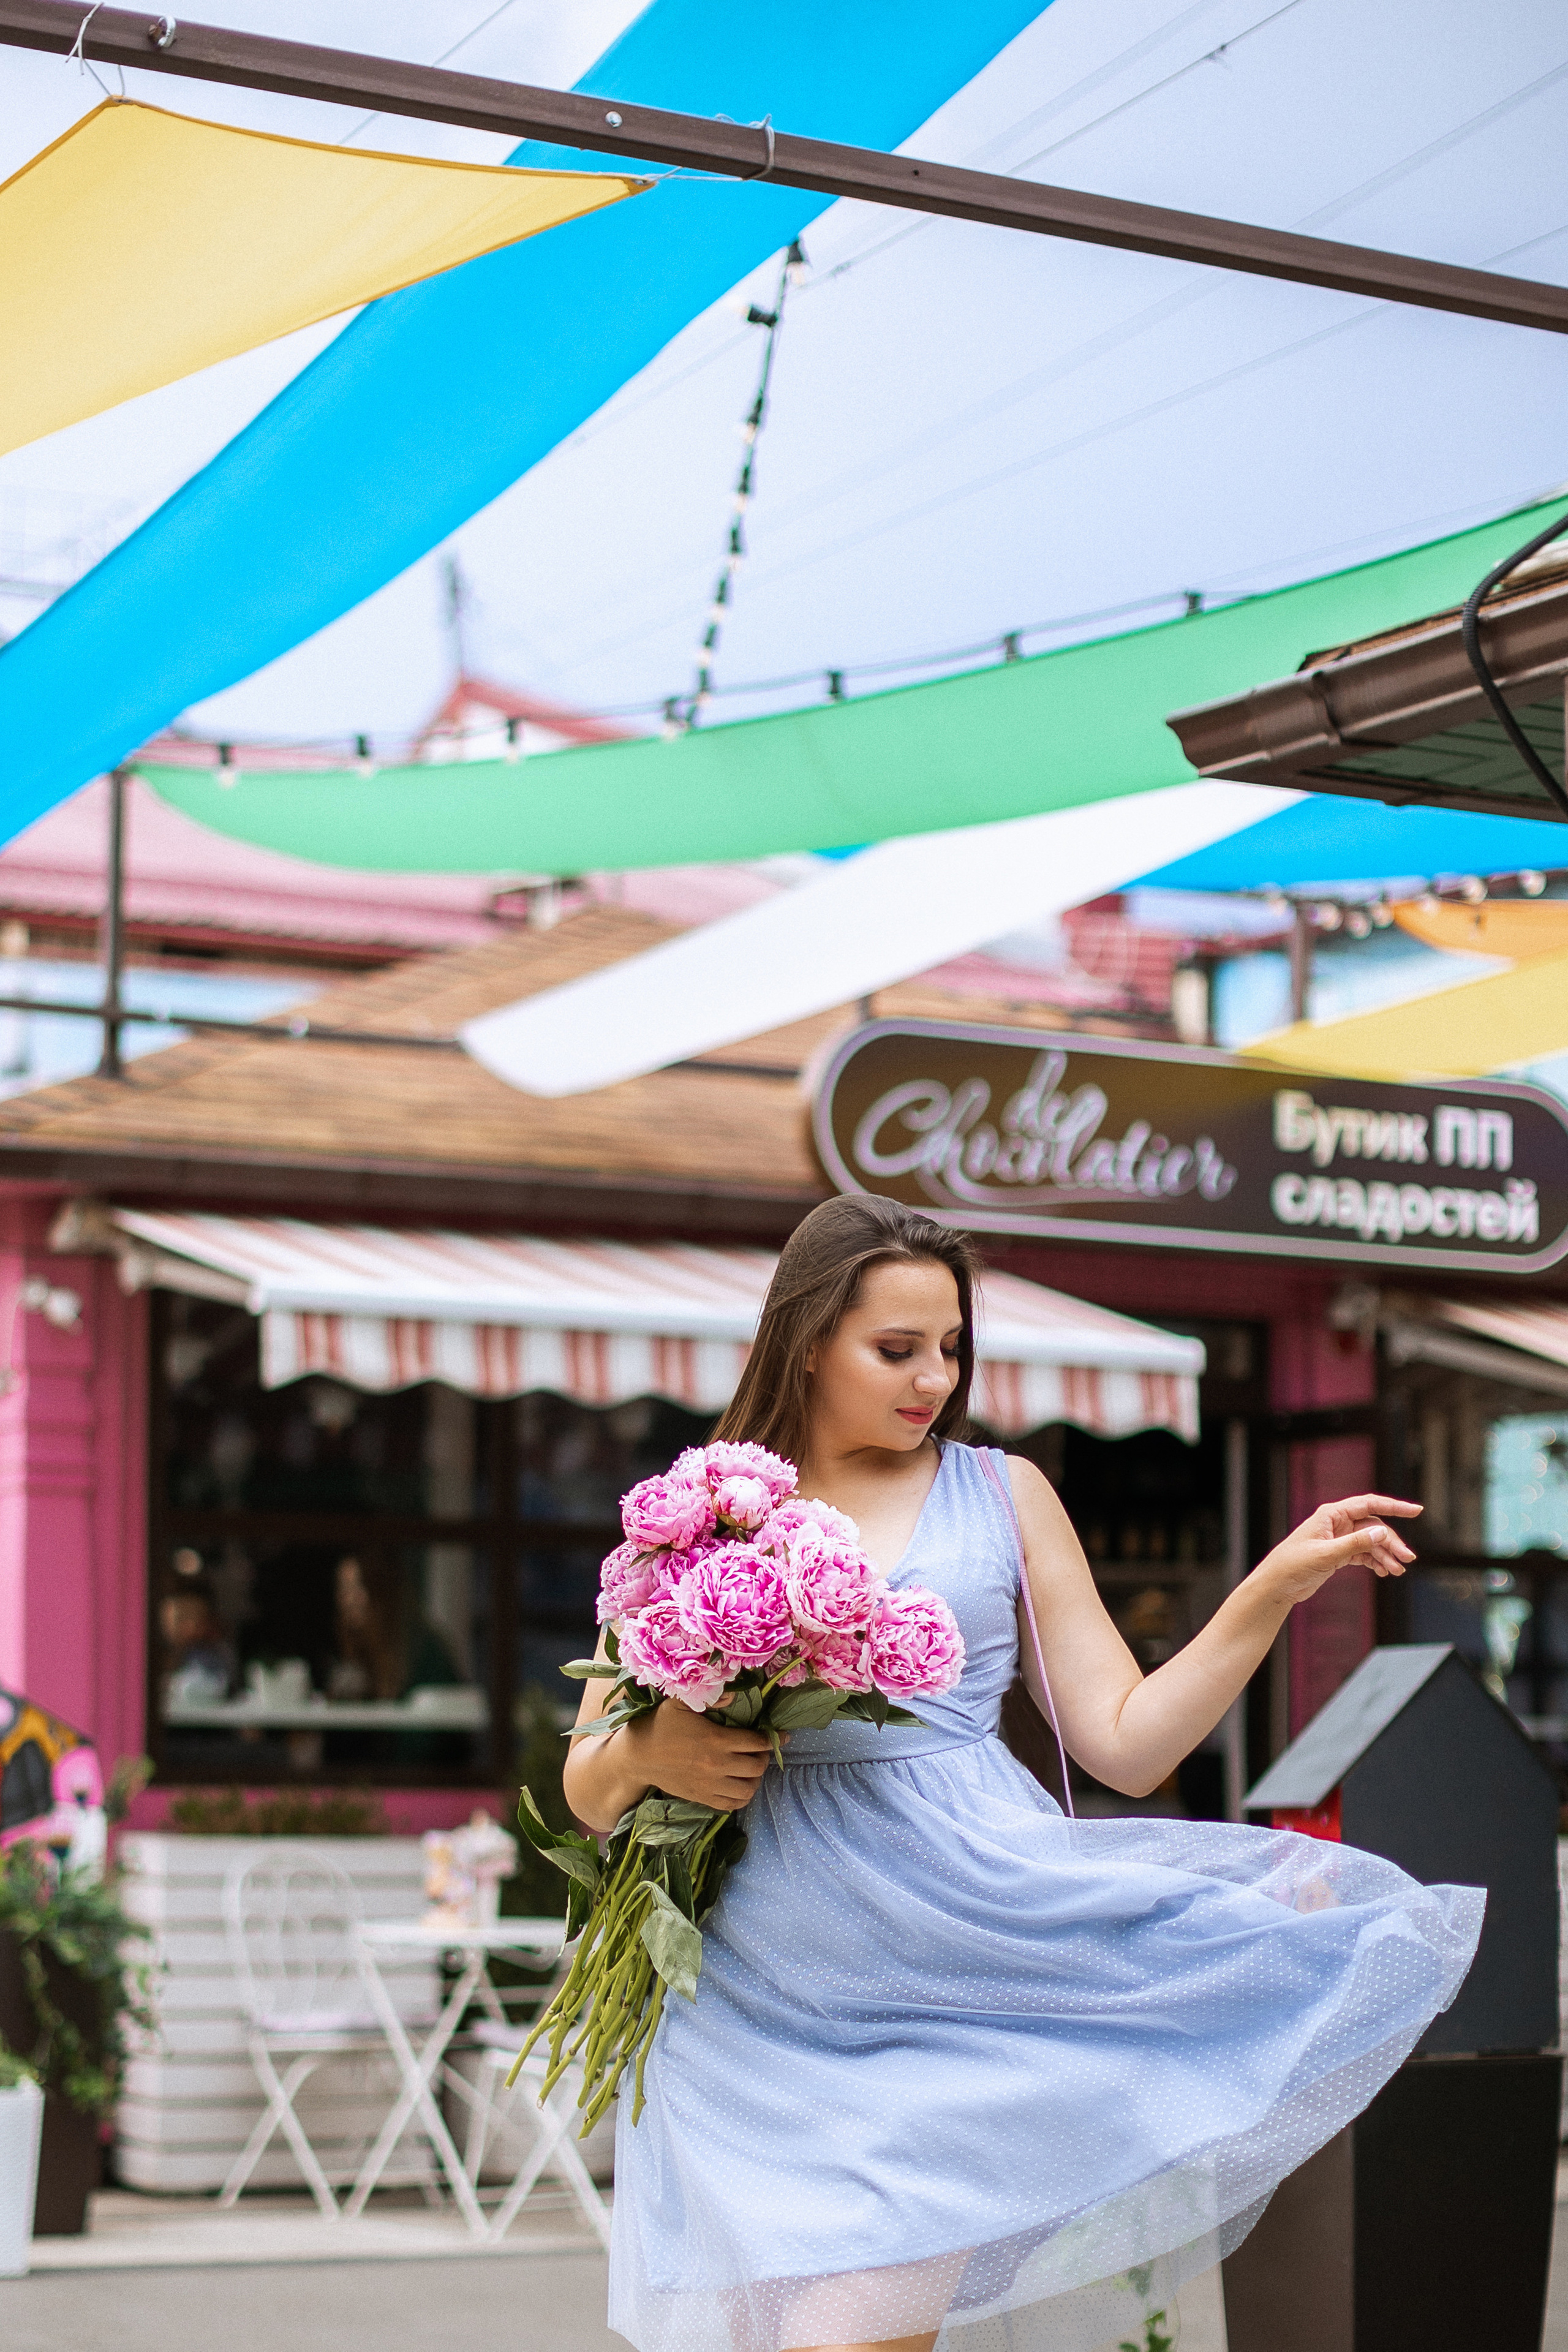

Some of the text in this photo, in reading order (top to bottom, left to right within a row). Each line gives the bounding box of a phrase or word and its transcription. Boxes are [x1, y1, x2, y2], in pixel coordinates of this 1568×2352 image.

[853, 1076, 1238, 1204] Chocolatier
[1272, 1088, 1514, 1172] Бутик ПП
[1270, 1171, 1540, 1245] сладостей
